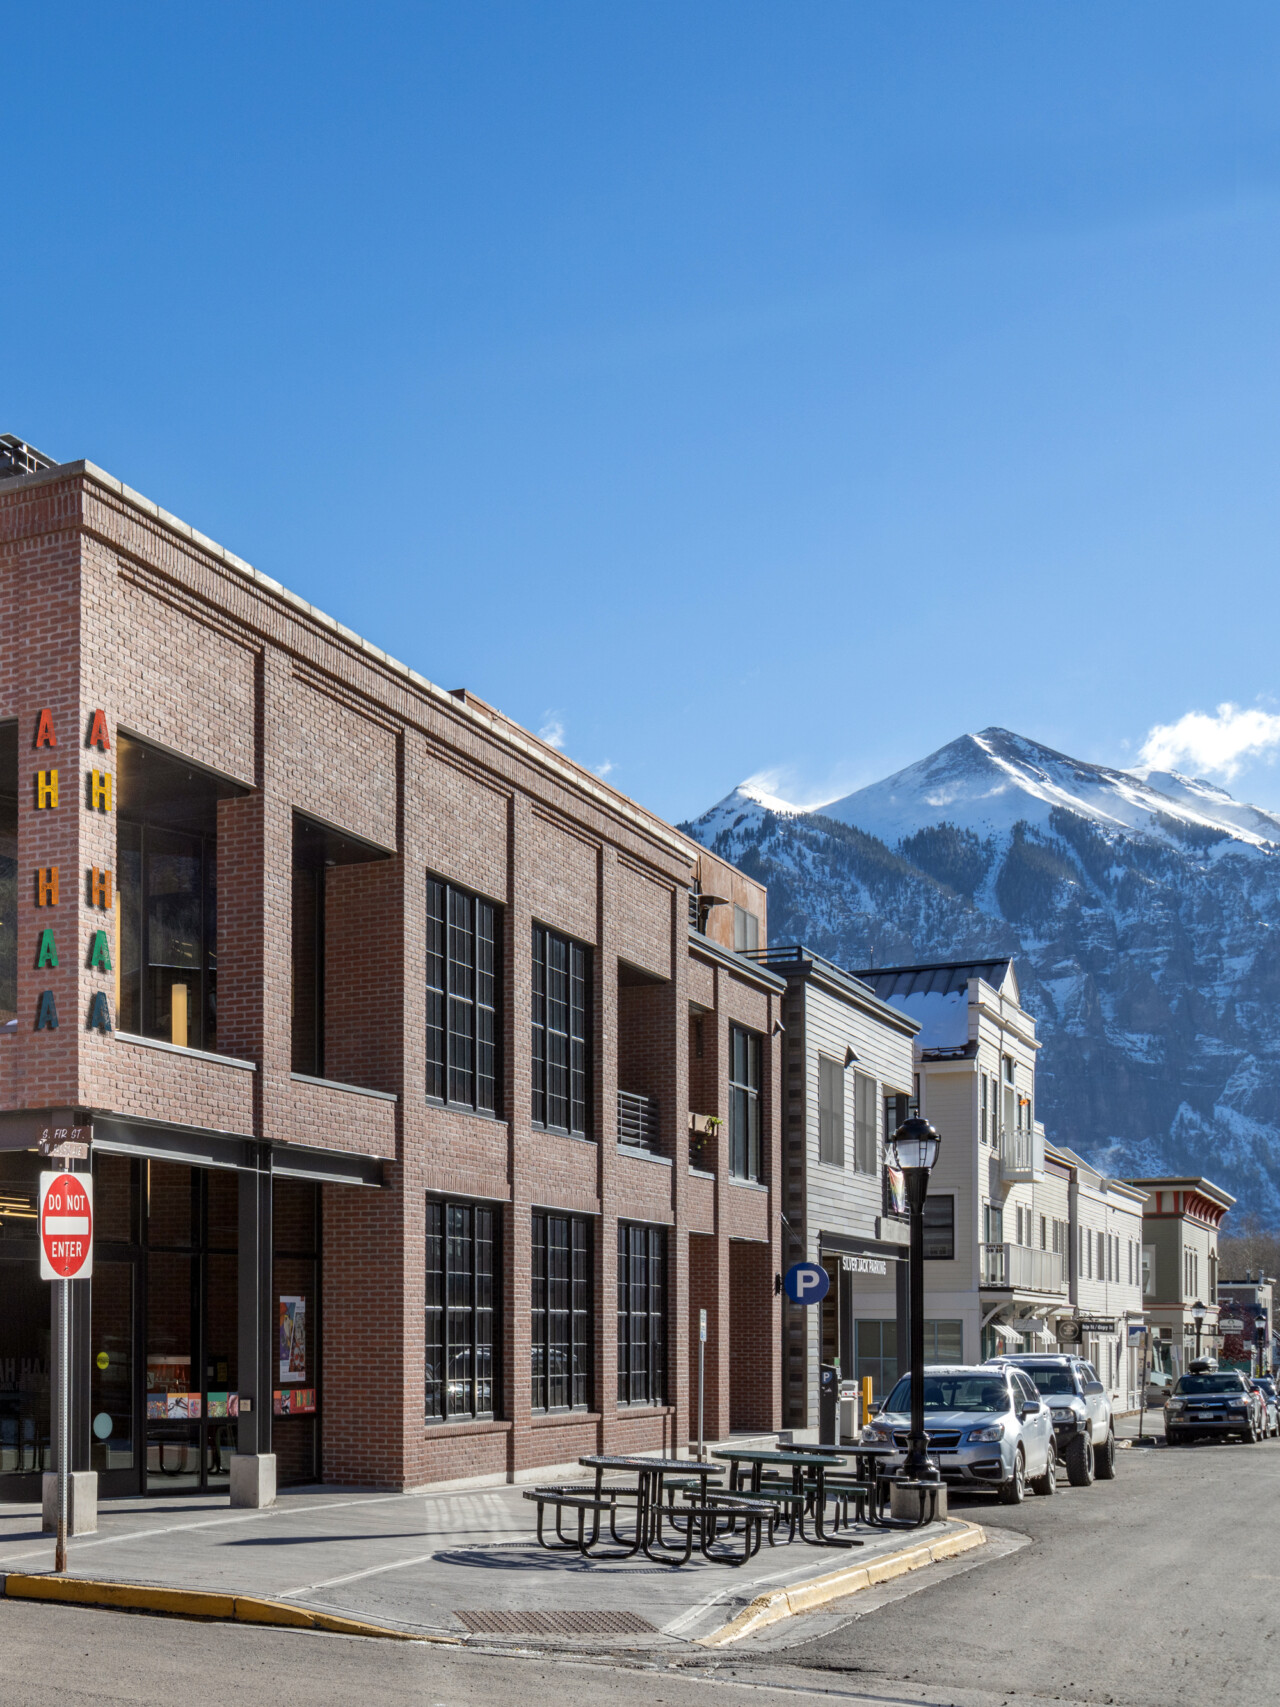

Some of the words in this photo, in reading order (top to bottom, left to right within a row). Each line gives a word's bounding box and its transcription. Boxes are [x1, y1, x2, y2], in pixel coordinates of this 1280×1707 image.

[54, 1129, 68, 1138] FIR
[48, 1194, 62, 1211] DO
[66, 1194, 86, 1211] NOT
[51, 1241, 83, 1258] ENTER
[842, 1255, 858, 1271] SILVER
[857, 1258, 870, 1273] JACK
[869, 1260, 887, 1276] PARKING
[796, 1270, 820, 1298] P
[822, 1371, 830, 1382] P
